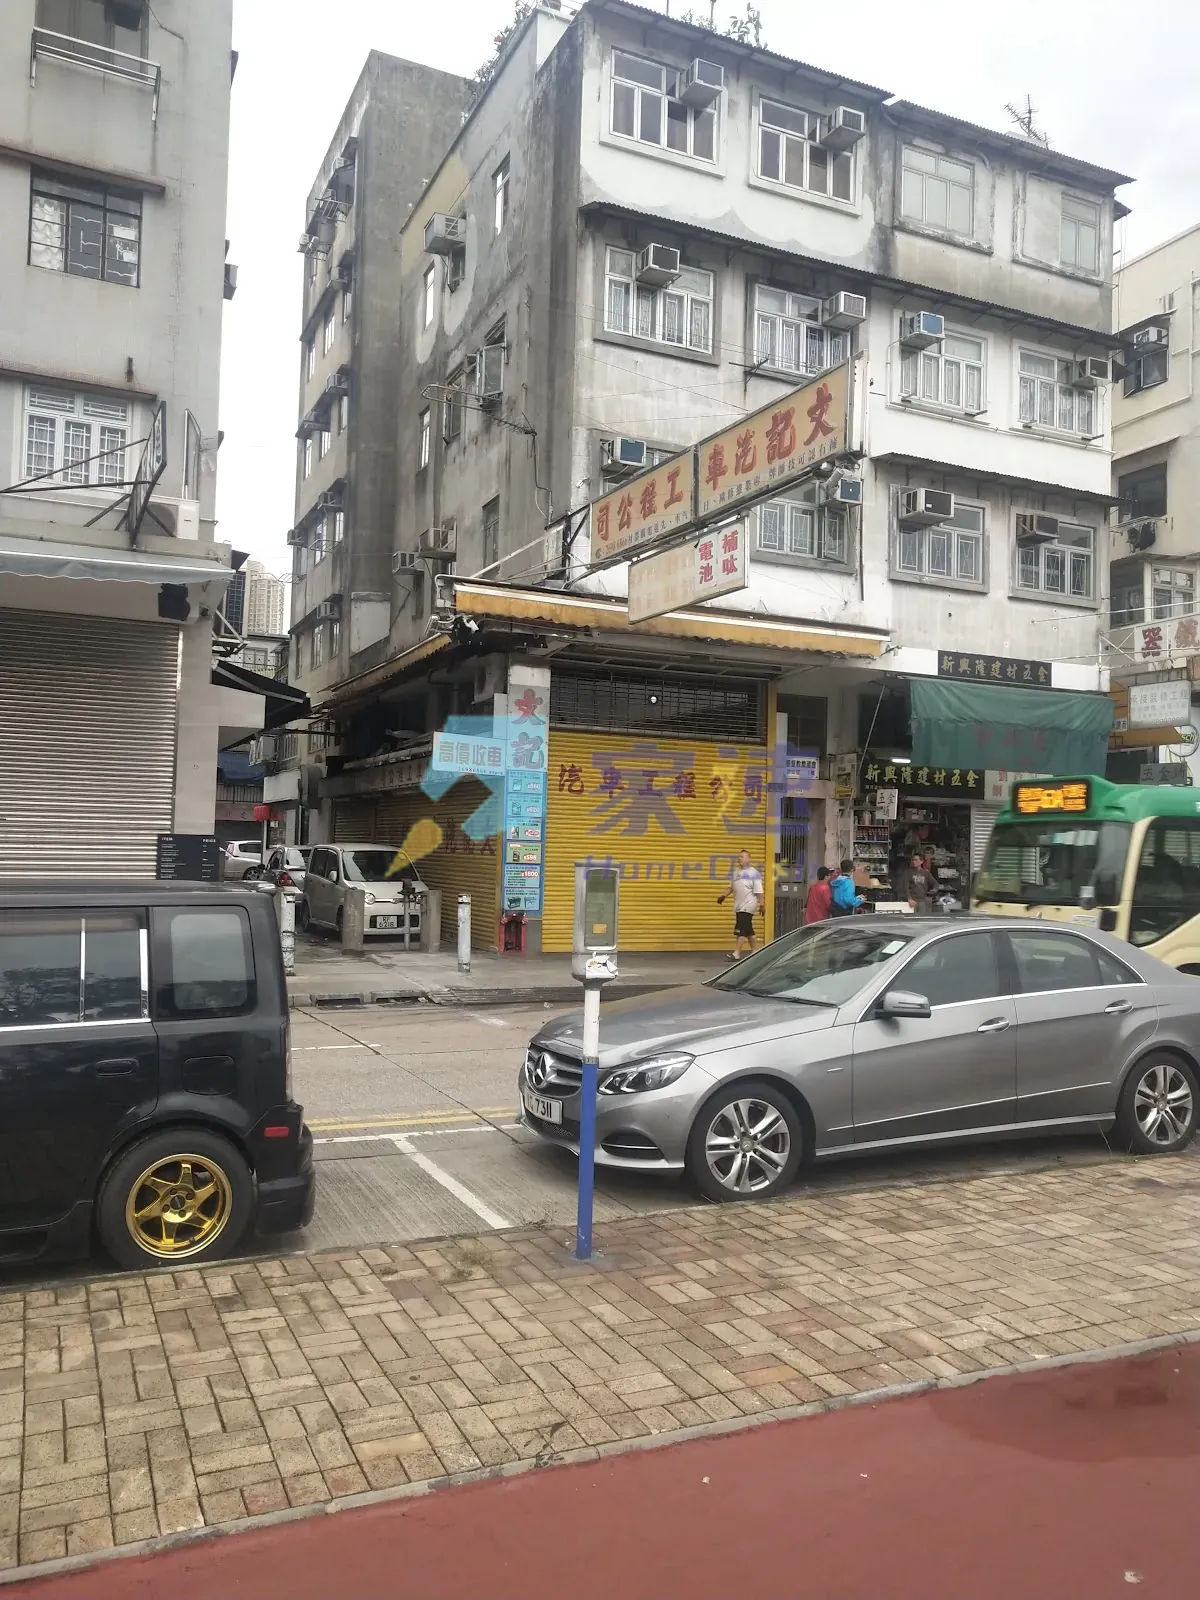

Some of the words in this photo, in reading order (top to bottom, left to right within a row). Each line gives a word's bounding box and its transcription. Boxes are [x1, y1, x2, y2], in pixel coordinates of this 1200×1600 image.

[698, 540, 714, 585] 電池
[722, 529, 739, 577] 補呔
[941, 655, 1049, 683] 新興隆建材五金
[438, 739, 503, 768] 高價收車
[559, 763, 762, 804] 汽車工程公司
[864, 763, 980, 788] 新興隆建材五金
[535, 1097, 552, 1119] 7311
